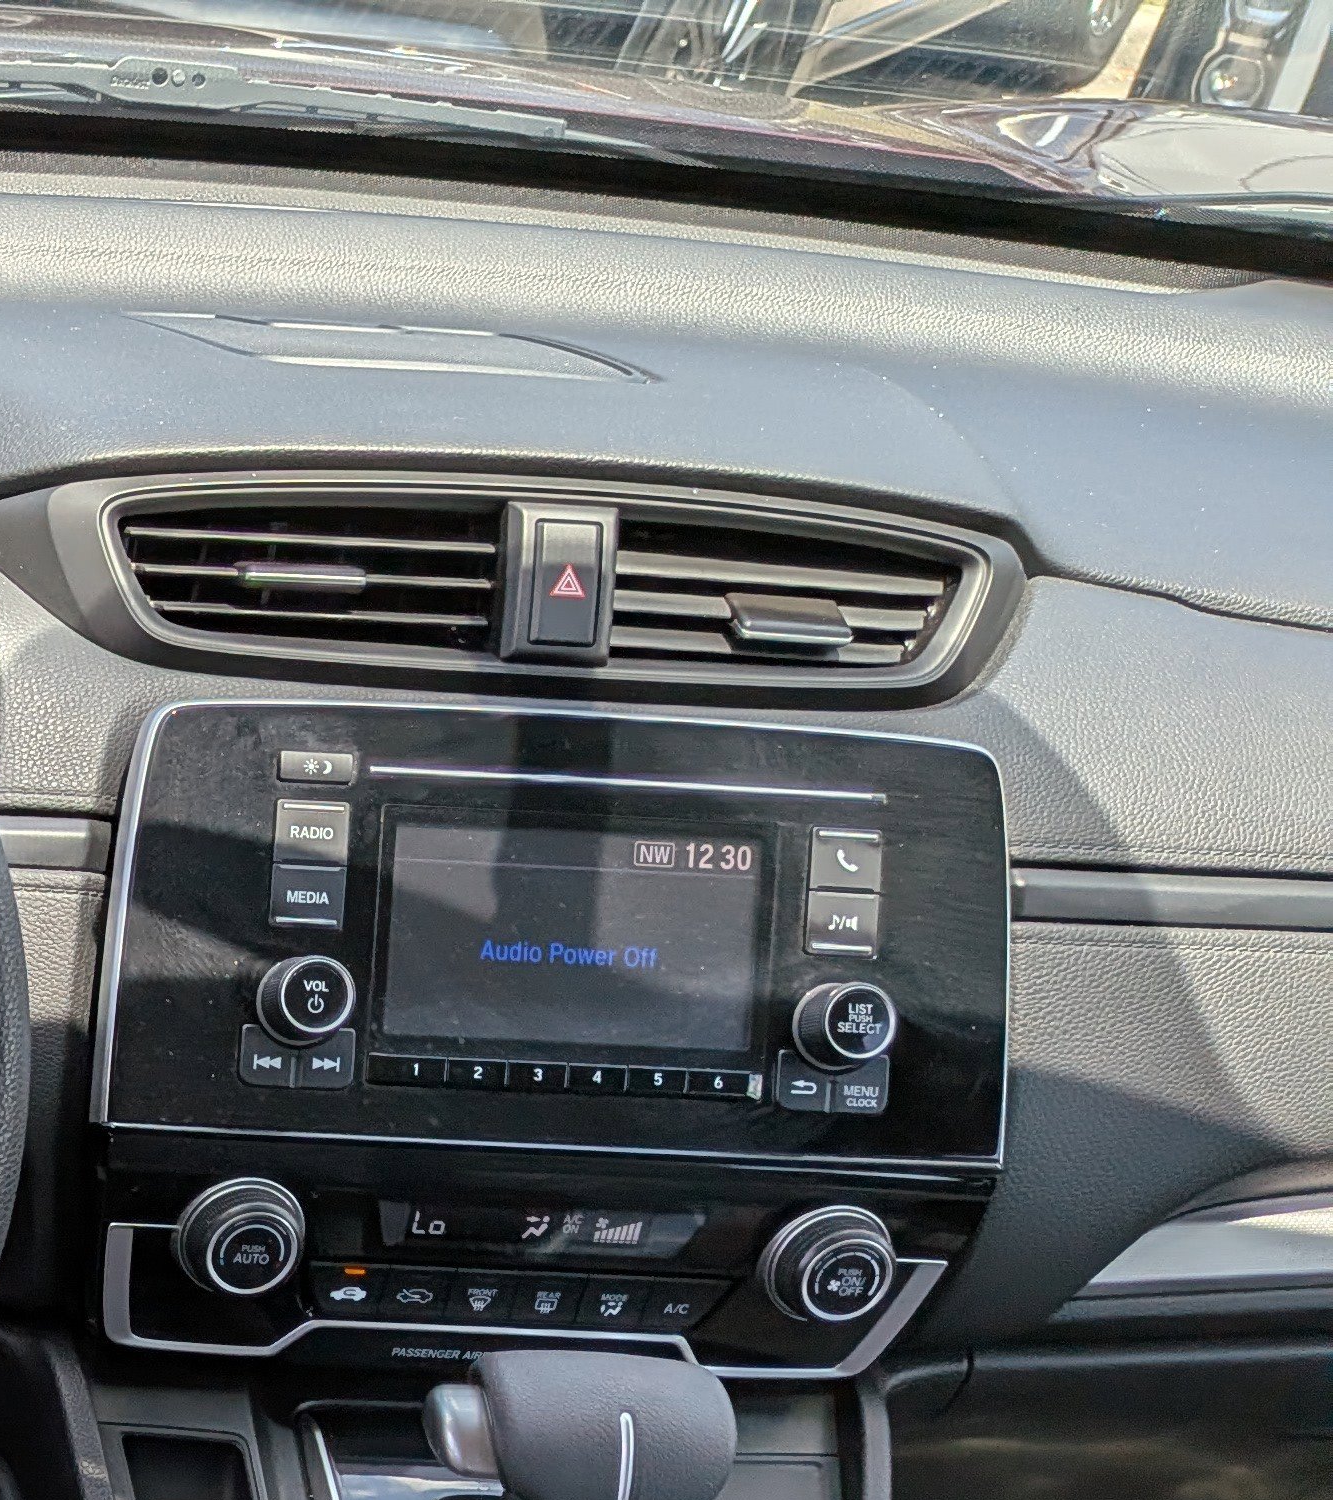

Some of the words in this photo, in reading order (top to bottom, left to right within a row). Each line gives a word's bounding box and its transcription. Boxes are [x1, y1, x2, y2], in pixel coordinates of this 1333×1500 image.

[289, 825, 334, 840] RADIO
[640, 846, 670, 864] NW
[286, 889, 330, 905] MEDIA
[480, 939, 541, 963] Audio
[548, 944, 613, 966] Power
[623, 946, 658, 968] Off
[303, 980, 329, 993] VOL
[848, 1003, 873, 1014] LIST
[837, 1022, 882, 1034] SELECT
[413, 1064, 419, 1077] 1
[473, 1066, 482, 1079] 2
[533, 1068, 543, 1082] 3
[592, 1070, 602, 1084] 4
[653, 1073, 662, 1086] 5
[714, 1075, 723, 1089] 6
[844, 1085, 879, 1097] MENU
[846, 1098, 877, 1108] CLOCK
[563, 1214, 583, 1225] A/C
[562, 1224, 580, 1234] ON
[233, 1252, 270, 1265] AUTO
[467, 1288, 499, 1297] FRONT
[537, 1291, 561, 1299] REAR
[601, 1293, 629, 1301] MODE
[838, 1286, 863, 1297] OFF
[664, 1303, 690, 1315] A/C
[391, 1347, 462, 1359] PASSENGER
